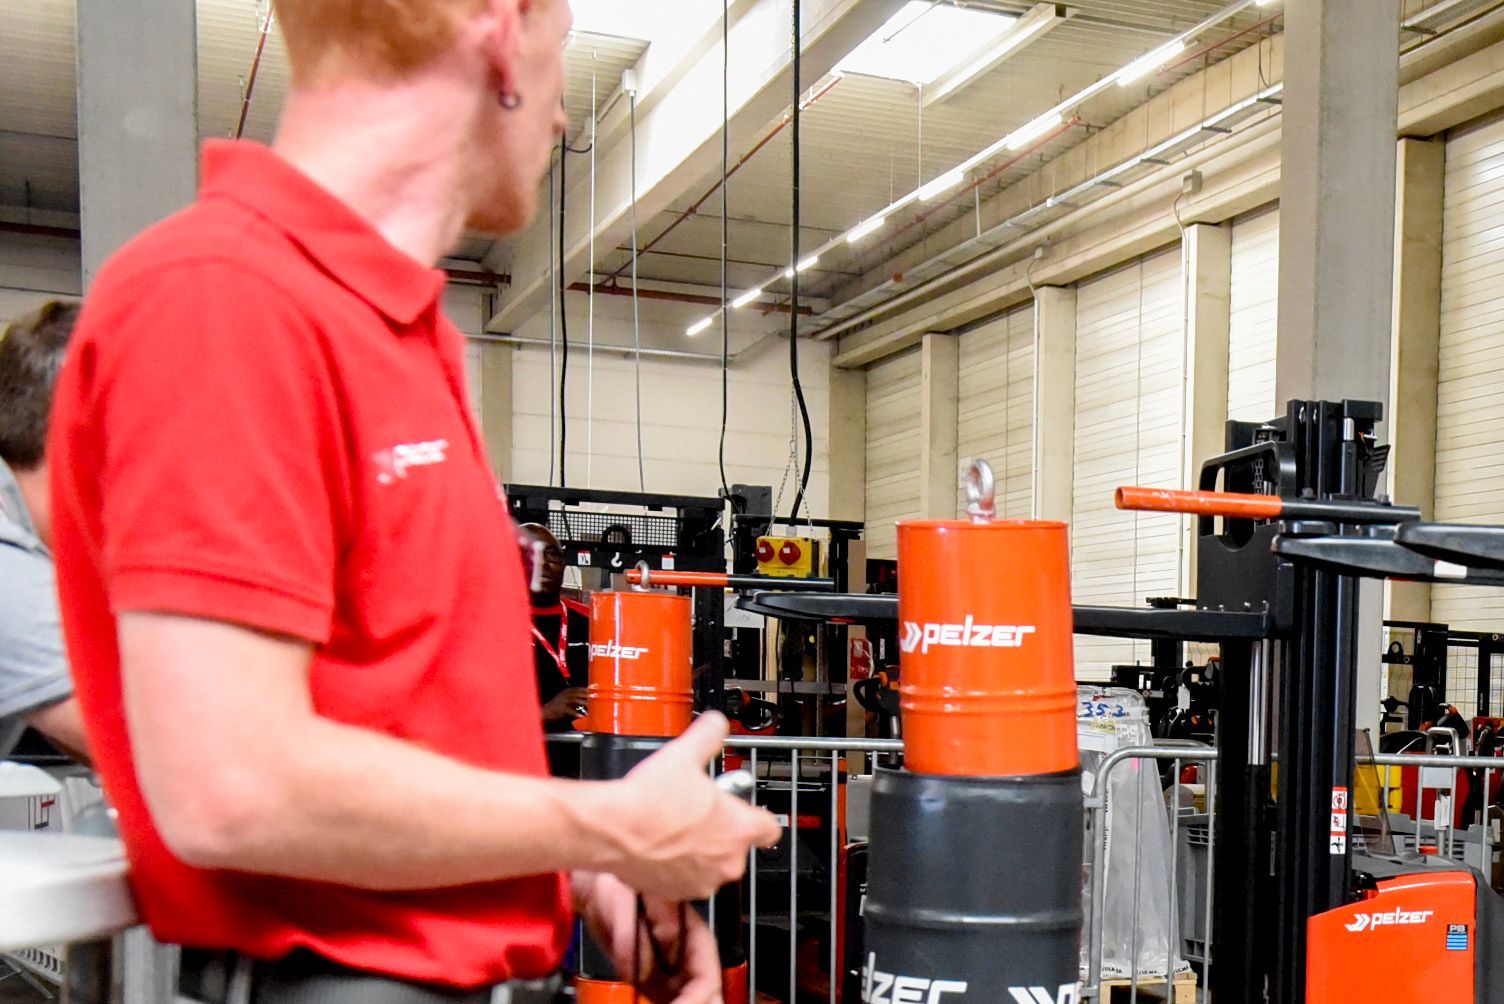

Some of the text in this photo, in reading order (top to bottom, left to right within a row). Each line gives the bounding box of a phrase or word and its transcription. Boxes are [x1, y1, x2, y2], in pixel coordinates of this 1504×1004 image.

[922, 614, 1036, 655] pelzer
[589, 639, 649, 662] pelzer
[1370, 905, 1435, 931] pelzer
